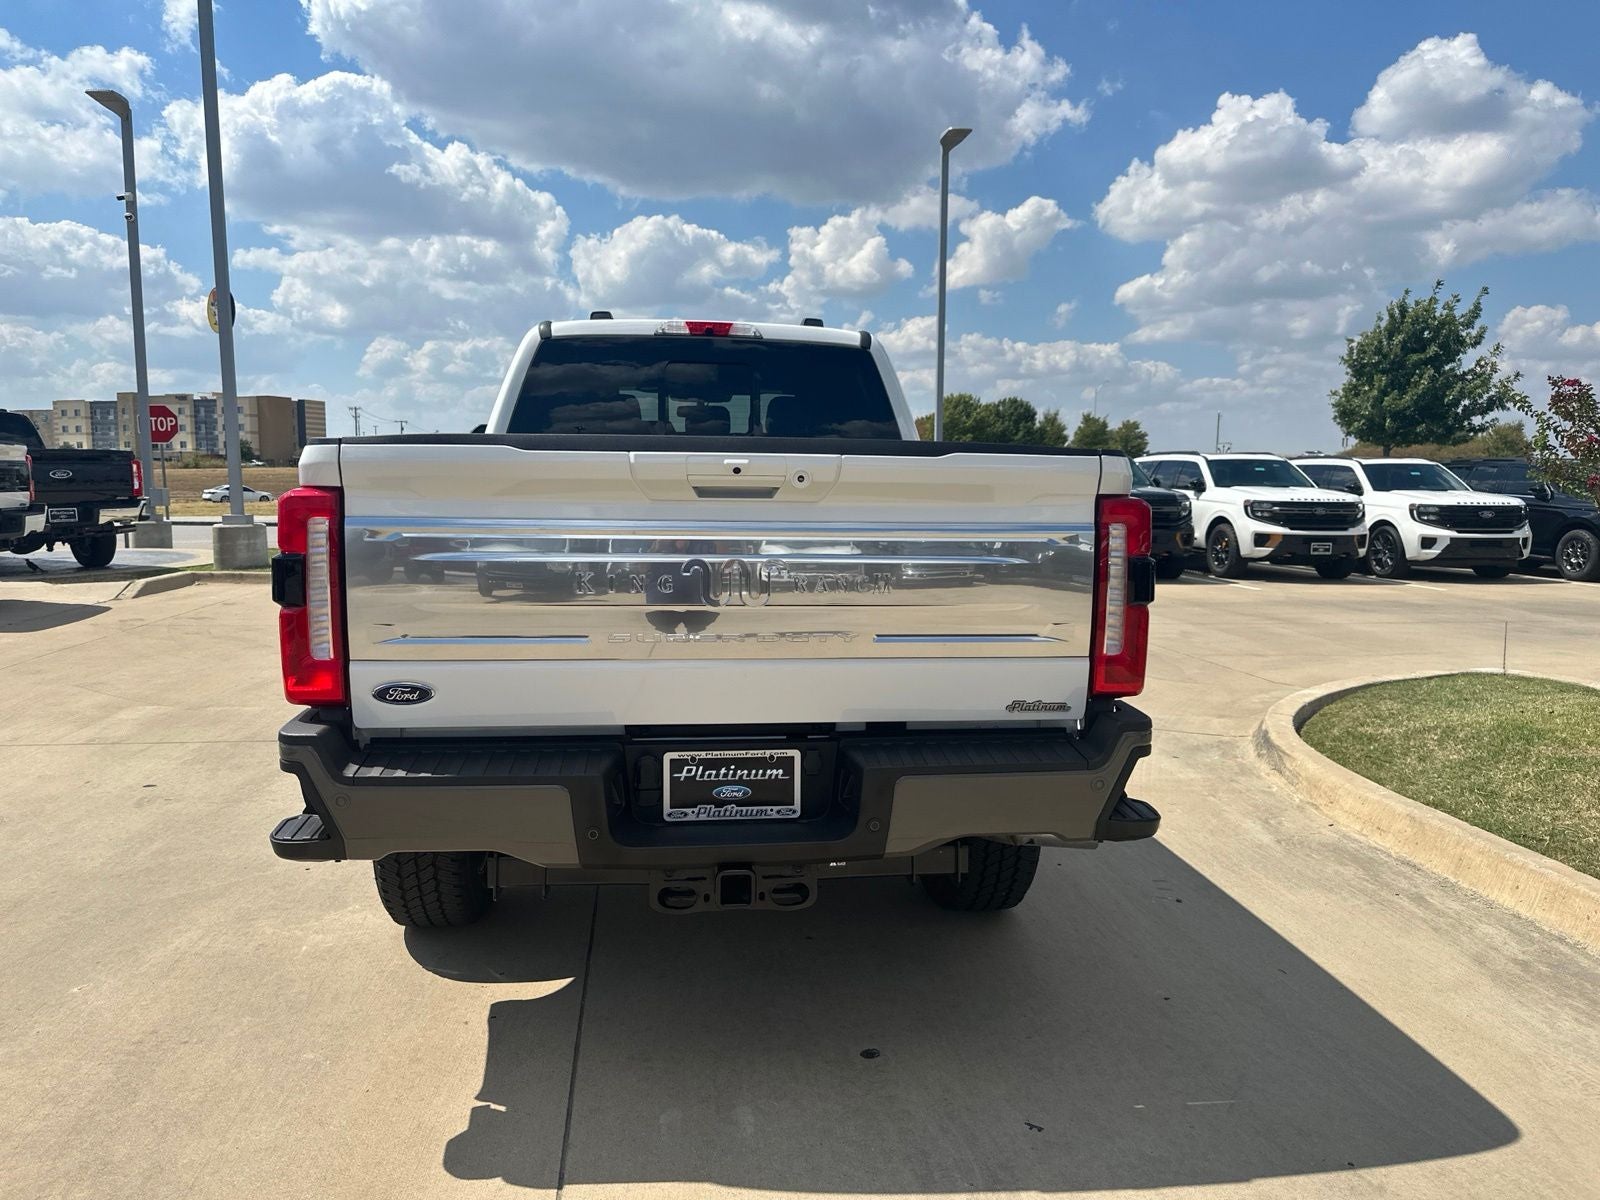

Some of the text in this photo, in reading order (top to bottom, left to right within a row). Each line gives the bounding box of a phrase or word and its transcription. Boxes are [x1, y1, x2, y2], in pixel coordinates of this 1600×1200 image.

[149, 416, 176, 432] TOP
[575, 571, 894, 594] KING RANCH
[607, 630, 859, 644] SUPER DUTY
[1006, 699, 1072, 713] Platinum
[677, 750, 788, 759] www.PlatinumFord.com
[672, 765, 790, 782] Platinum
[695, 805, 772, 819] Platinum
